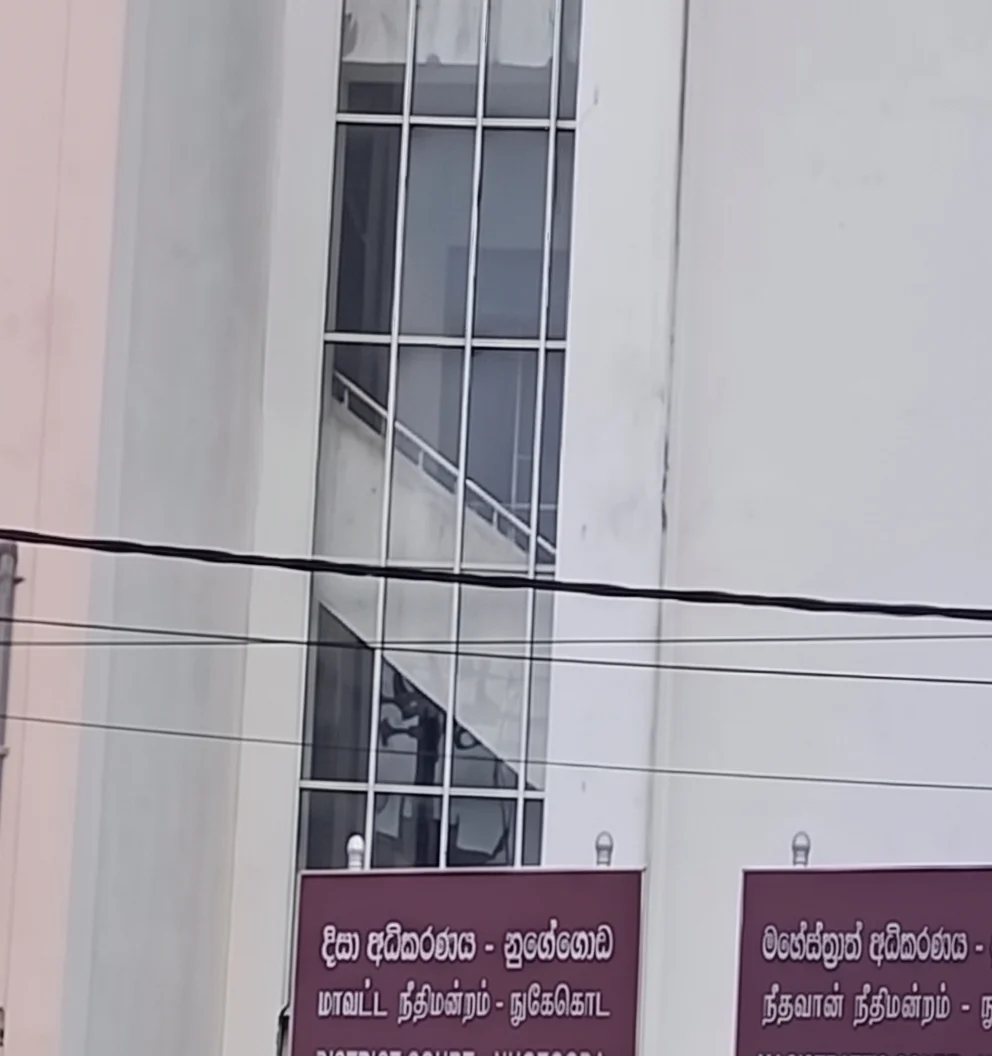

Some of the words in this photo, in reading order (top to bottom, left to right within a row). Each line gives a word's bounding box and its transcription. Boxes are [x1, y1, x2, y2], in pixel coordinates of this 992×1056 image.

[320, 924, 361, 969] දිසා
[365, 921, 477, 968] අධිකරණය
[503, 918, 614, 970] නුගේගොඩ
[868, 921, 969, 968] අධිකරණය
[317, 977, 389, 1017] மாவட்ட
[396, 978, 492, 1025] நீதிமன்றம்
[509, 981, 612, 1028] நுகேகொட
[761, 981, 845, 1027] நீதவான்
[852, 981, 951, 1028] நீதிமன்றம்
